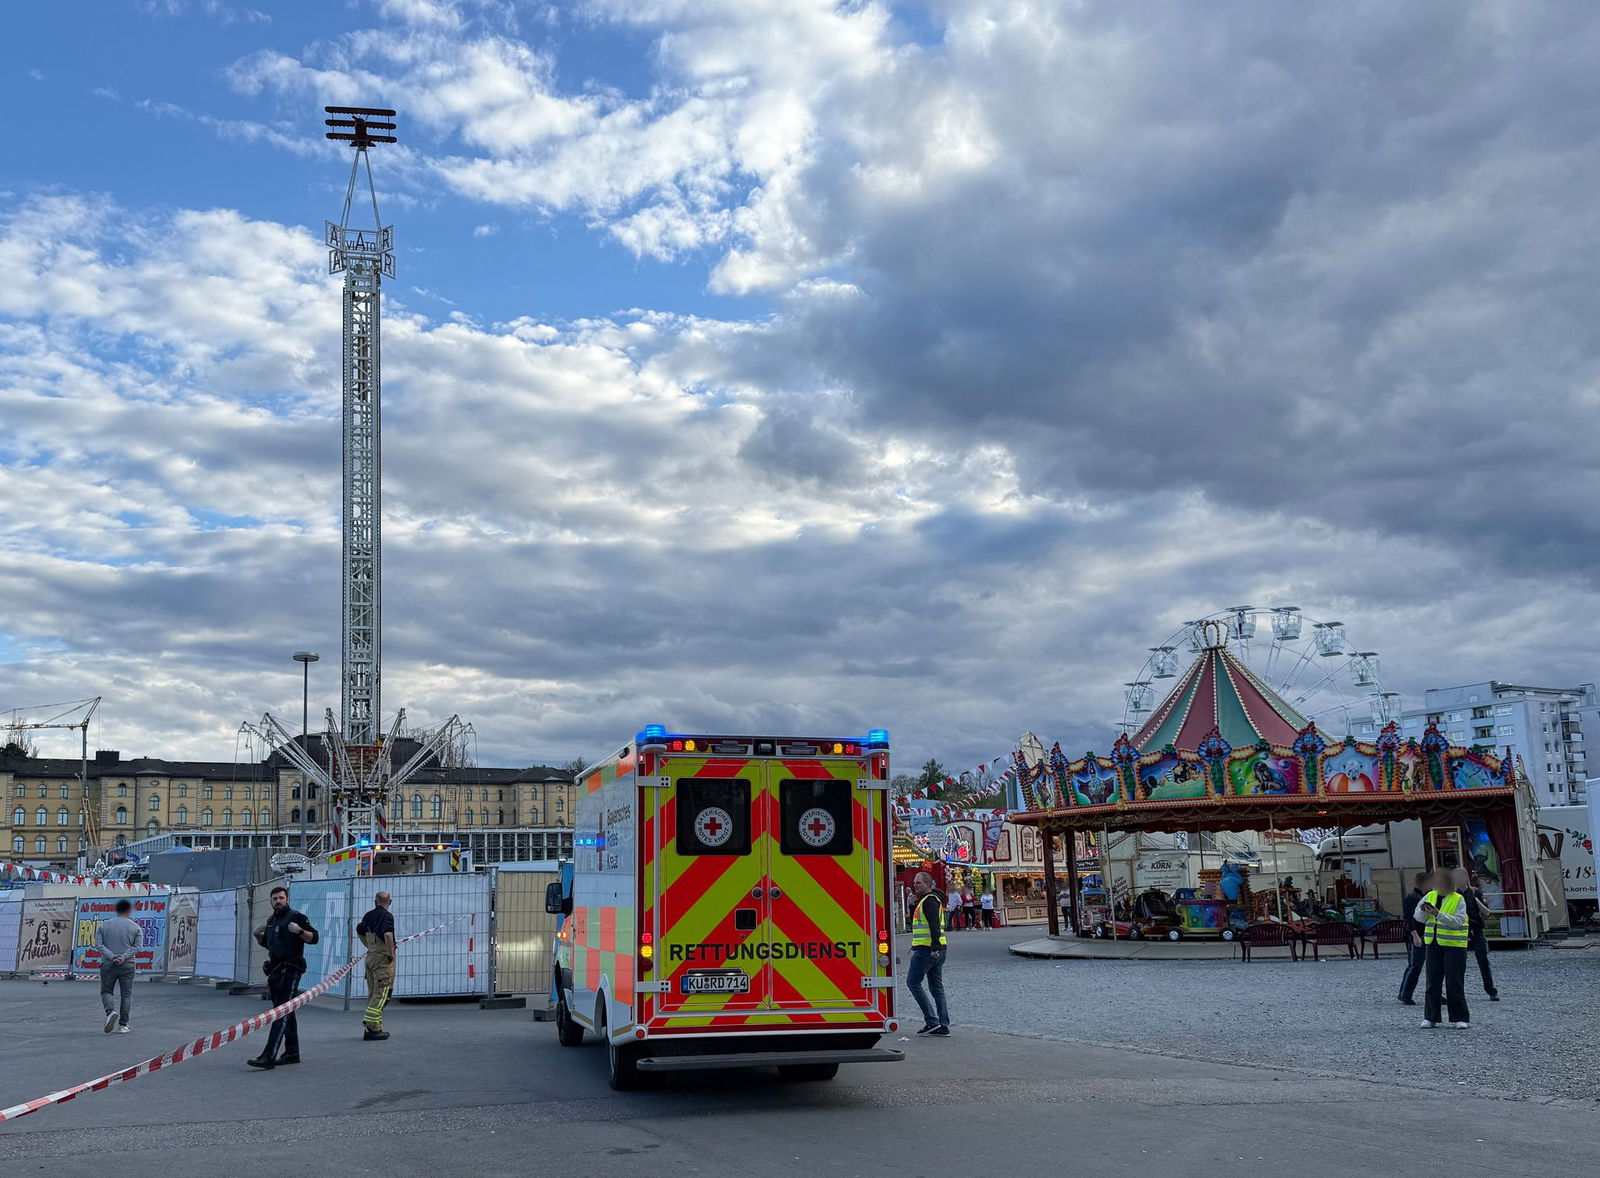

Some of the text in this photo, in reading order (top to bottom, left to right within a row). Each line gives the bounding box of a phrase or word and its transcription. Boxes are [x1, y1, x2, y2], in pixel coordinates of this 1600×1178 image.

[1576, 865, 1597, 879] 18
[21, 938, 62, 963] Aviator
[669, 941, 861, 961] RETTUNGSDIENST
[688, 975, 747, 990] KU RD 714
